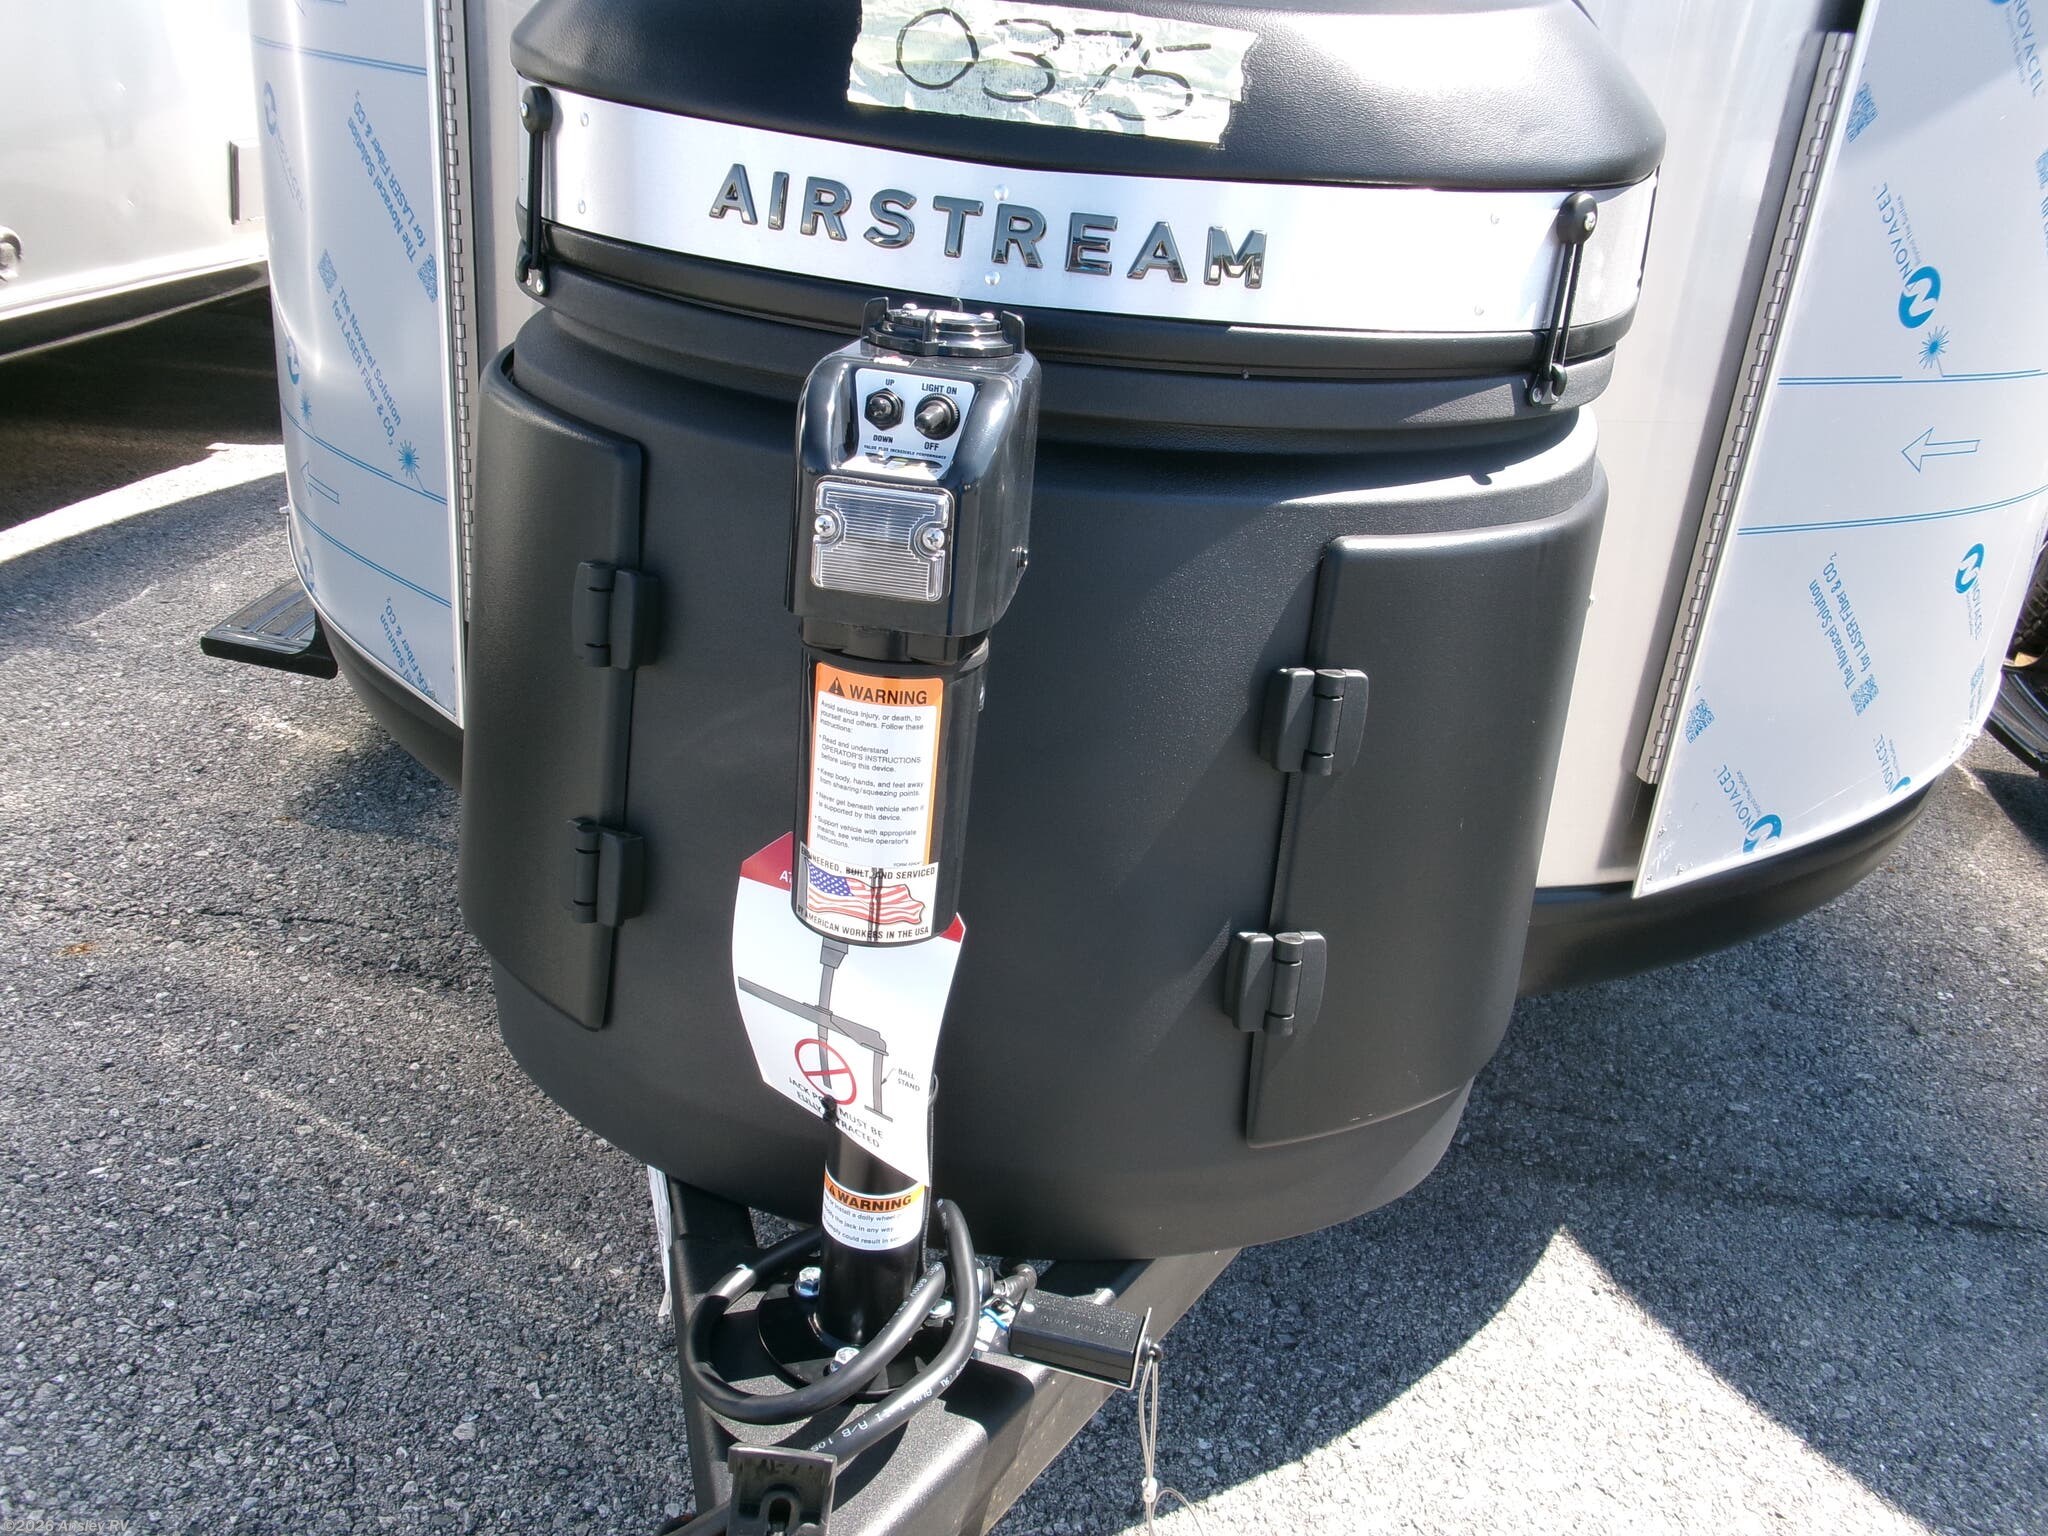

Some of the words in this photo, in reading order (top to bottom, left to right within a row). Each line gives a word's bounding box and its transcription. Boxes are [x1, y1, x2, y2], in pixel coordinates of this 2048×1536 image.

[348, 118, 376, 177] Solution
[371, 137, 390, 176] Fiber
[373, 176, 404, 235] Novacel
[387, 174, 415, 224] LASER
[412, 224, 426, 247] for
[708, 162, 1268, 290] AIRSTREAM
[402, 232, 416, 263] The
[332, 300, 343, 322] for
[341, 321, 363, 368] LASER
[360, 367, 378, 403] Fiber
[338, 286, 351, 316] The
[350, 314, 376, 369] Novacel
[374, 368, 403, 426] Solution
[922, 383, 944, 393] LIGHT
[946, 386, 957, 395] ON
[873, 434, 894, 444] DOWN
[924, 442, 940, 451] OFF
[1808, 579, 1833, 629] Solution
[1836, 590, 1853, 624] Fiber
[1846, 614, 1866, 656] LASER
[401, 638, 419, 674] Fiber
[1824, 624, 1852, 668] Novacel
[1860, 652, 1872, 673] for
[1843, 663, 1856, 690] The
[850, 684, 927, 704] WARNING
[820, 710, 841, 721] yourself
[843, 716, 854, 725] and
[856, 719, 879, 729] others.
[821, 700, 835, 711] Avoid
[837, 705, 858, 716] serious
[860, 711, 880, 721] injury,
[892, 714, 912, 722] death,
[822, 734, 837, 746] Read
[838, 739, 849, 749] and
[851, 743, 888, 754] understand
[822, 743, 863, 760] OPERATOR'S
[865, 755, 921, 764] INSTRUCTIONS
[821, 753, 838, 763] before
[840, 758, 856, 769] using
[858, 762, 870, 770] this
[820, 768, 834, 780] Keep
[853, 778, 875, 787] hands,
[820, 777, 832, 786] from
[899, 788, 920, 797] points.
[819, 792, 834, 802] Never
[836, 797, 846, 807] get
[847, 801, 873, 810] beneath
[1716, 764, 1756, 829] NOVACEL
[824, 804, 853, 817] supported
[854, 810, 863, 818] by
[818, 816, 838, 828] Support
[840, 823, 862, 834] vehicle
[880, 829, 916, 837] appropriate
[851, 834, 874, 844] vehicle
[876, 837, 908, 845] operator's
[896, 867, 936, 879] SERVICED
[805, 909, 840, 933] AMERICAN
[842, 926, 883, 939] WORKERS
[886, 930, 895, 938] IN
[897, 929, 913, 938] THE
[915, 926, 929, 936] USA
[898, 1068, 915, 1080] BALL
[898, 1078, 920, 1092] STAND
[789, 1076, 810, 1096] JACK
[839, 1108, 867, 1129] MUST
[871, 1126, 883, 1139] BE
[838, 1190, 912, 1211] WARNING
[844, 1222, 857, 1230] jack
[857, 1214, 874, 1222] dolly
[842, 1233, 859, 1242] could
